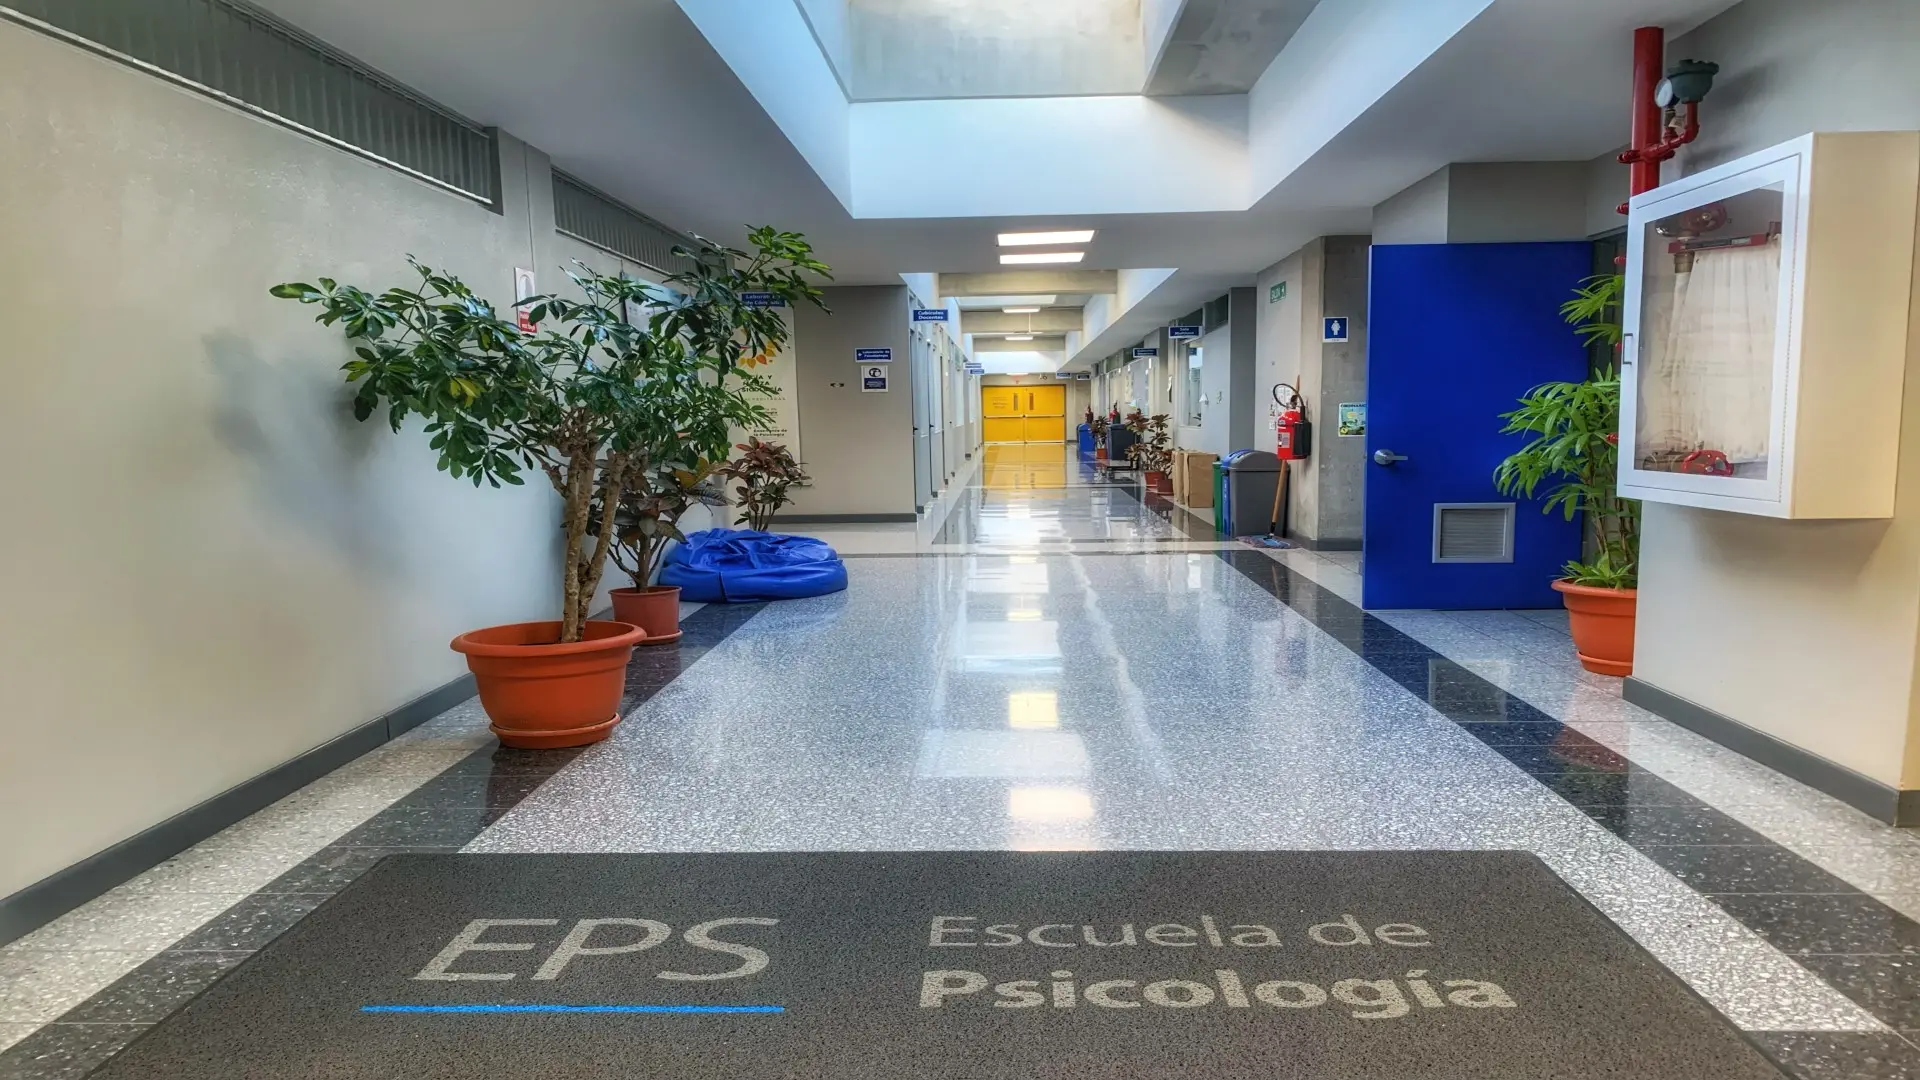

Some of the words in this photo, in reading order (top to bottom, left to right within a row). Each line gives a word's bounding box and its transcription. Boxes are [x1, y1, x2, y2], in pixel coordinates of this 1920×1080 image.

[407, 917, 780, 981] EPS
[928, 915, 1284, 948] Escuela
[1307, 914, 1432, 947] de
[918, 969, 1518, 1019] Psicología
